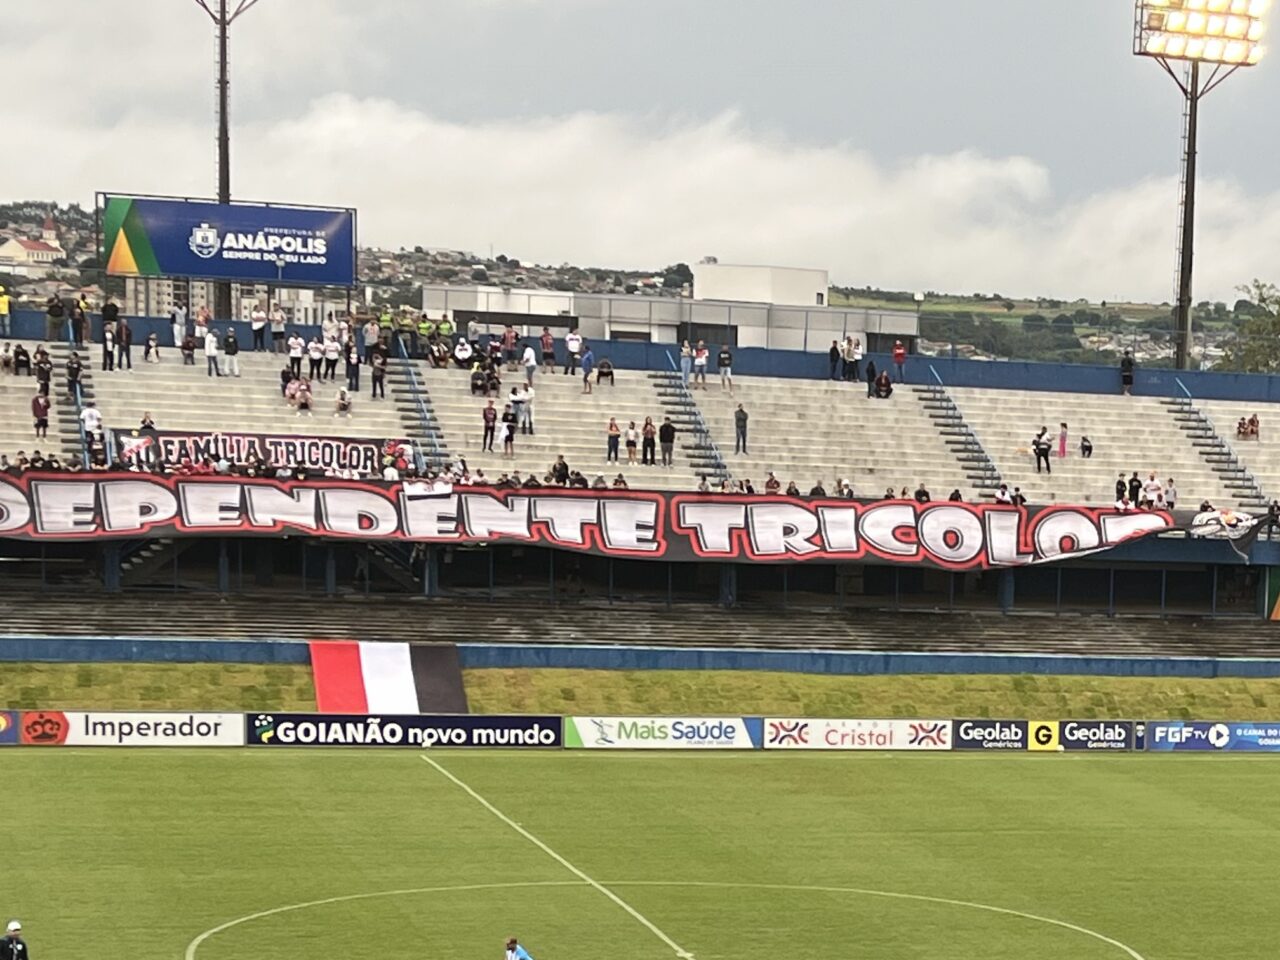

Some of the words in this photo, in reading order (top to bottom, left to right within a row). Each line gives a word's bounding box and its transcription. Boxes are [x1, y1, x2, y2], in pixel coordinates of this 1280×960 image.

[222, 231, 327, 254] ANÁPOLIS
[222, 250, 262, 261] SEMPRE
[263, 252, 278, 261] DO
[300, 255, 327, 265] LADO
[159, 432, 263, 465] FAMÍLIA
[265, 438, 378, 473] TRICOLOR
[84, 714, 223, 743] Imperador
[276, 718, 404, 743] GOIANÃO
[408, 727, 467, 744] novo
[472, 723, 556, 745] mundo
[617, 720, 669, 740] Mais
[671, 720, 736, 740] Saúde
[825, 728, 894, 746] Cristal
[959, 722, 1022, 740] Geolab
[1034, 725, 1052, 745] G
[1064, 723, 1126, 741] Geolab
[1155, 727, 1194, 743] FGF
[1193, 730, 1209, 740] TV
[1236, 728, 1242, 737] O
[1267, 729, 1278, 737] DO
[982, 740, 1023, 748] Genéricos
[1087, 740, 1125, 749] Genéricos
